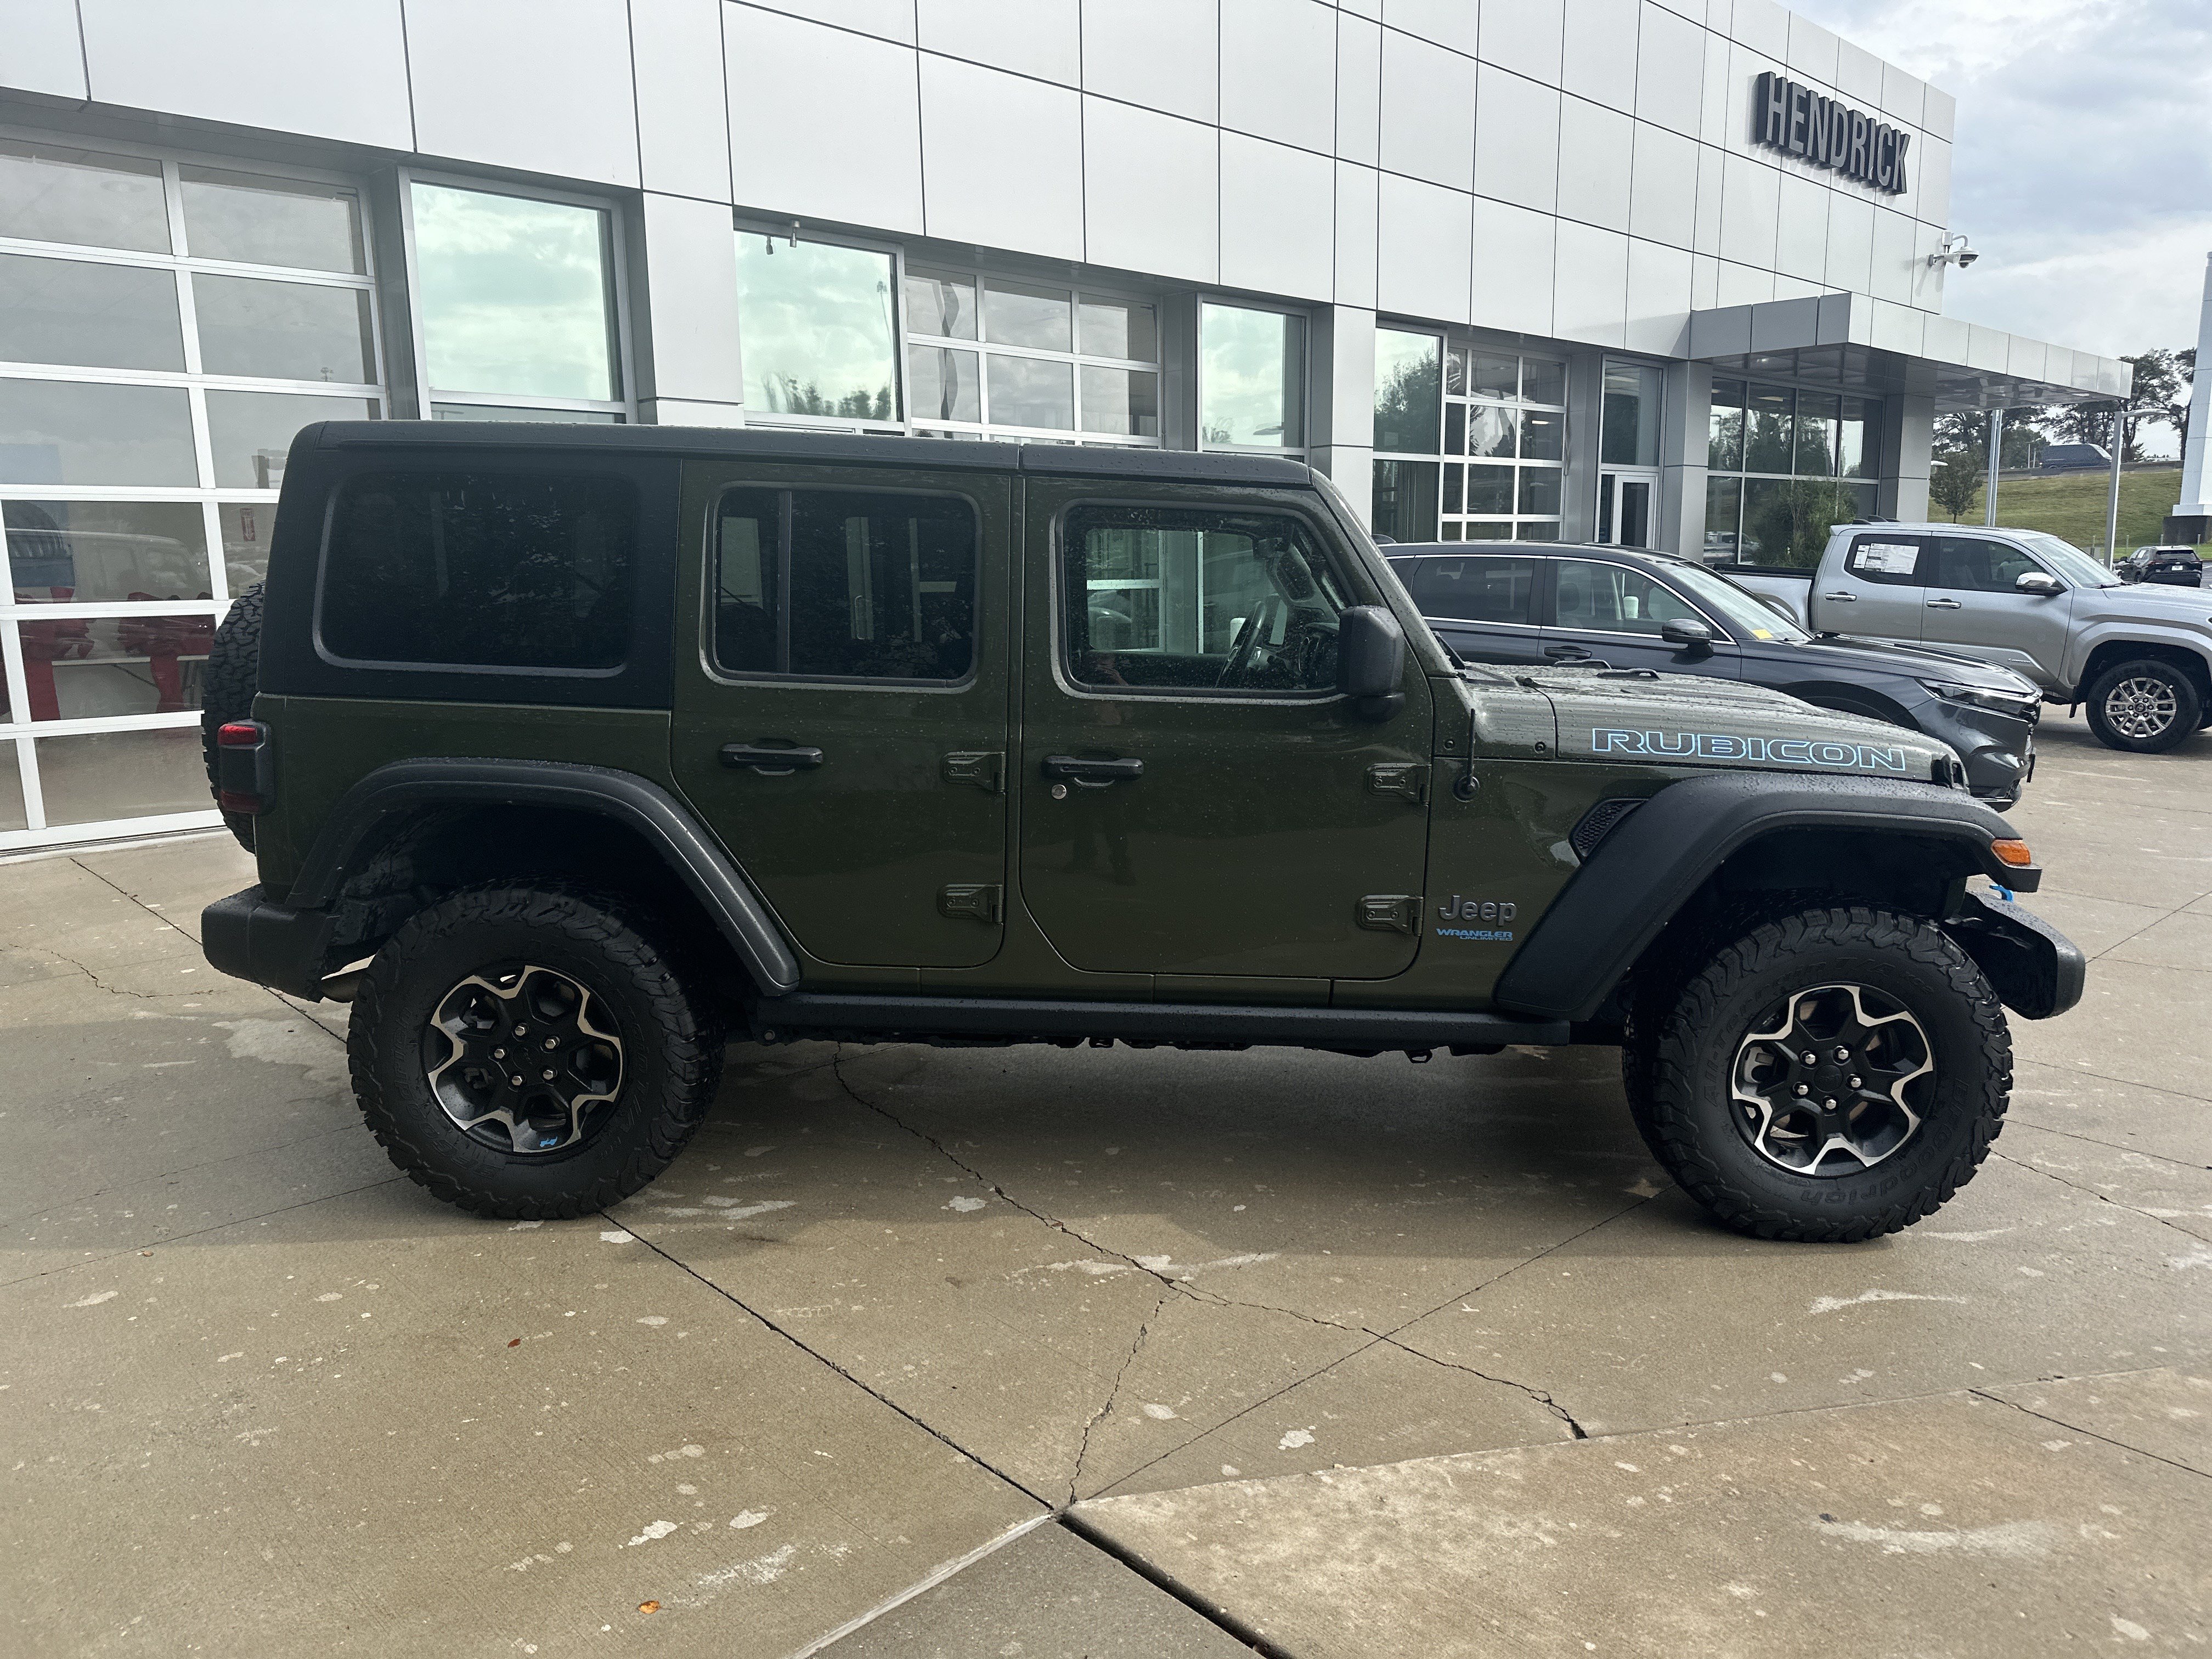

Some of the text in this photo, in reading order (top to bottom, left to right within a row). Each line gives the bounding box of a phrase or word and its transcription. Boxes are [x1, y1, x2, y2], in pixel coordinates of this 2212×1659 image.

[1757, 71, 1910, 195] HENDRICK
[1592, 727, 1906, 771] RUBICON
[1438, 894, 1517, 927] Jeep
[1436, 928, 1513, 938] WRANGLER
[1801, 1078, 1969, 1205] BFGoodrich
